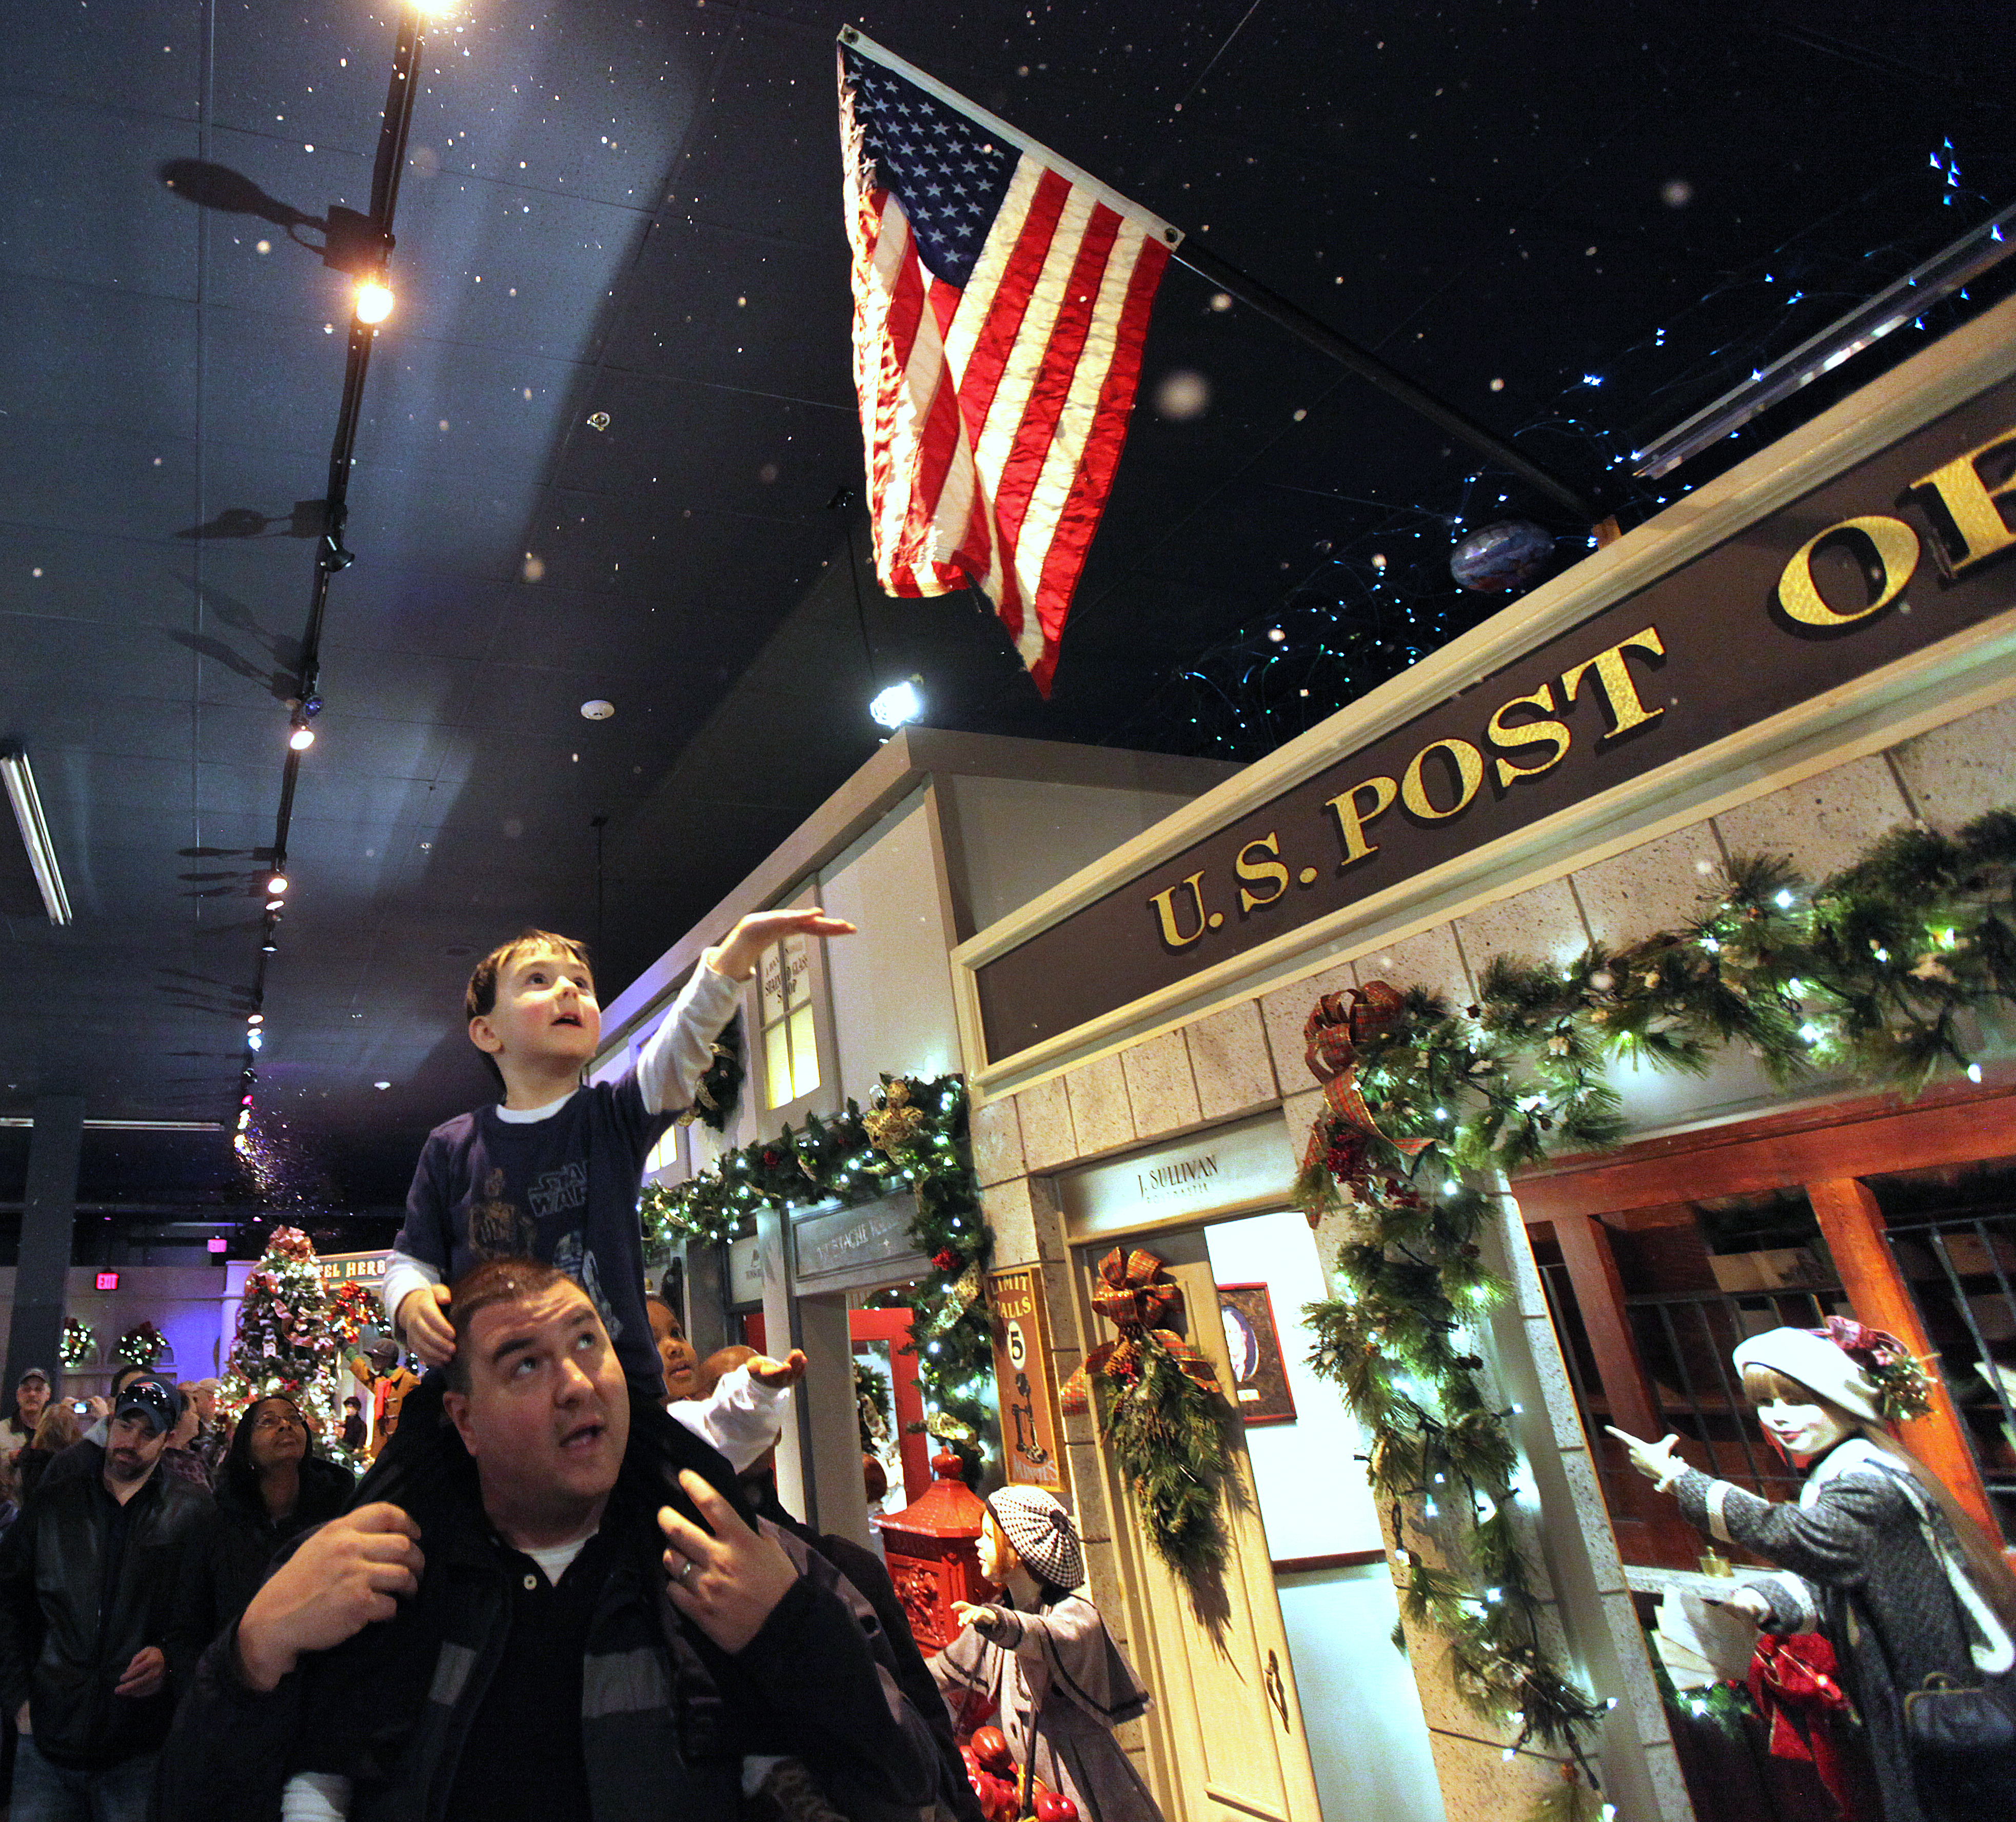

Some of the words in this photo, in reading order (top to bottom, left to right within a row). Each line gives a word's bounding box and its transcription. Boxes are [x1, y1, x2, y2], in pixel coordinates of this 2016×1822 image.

[1150, 831, 1318, 946] U.S.
[1325, 626, 1665, 866] POST
[1138, 1175, 1148, 1198] J.
[1149, 1154, 1218, 1190] SULLIVAN
[97, 1274, 118, 1289] EXIT
[990, 1274, 1028, 1295] LIMIT
[1010, 1331, 1023, 1360] 5
